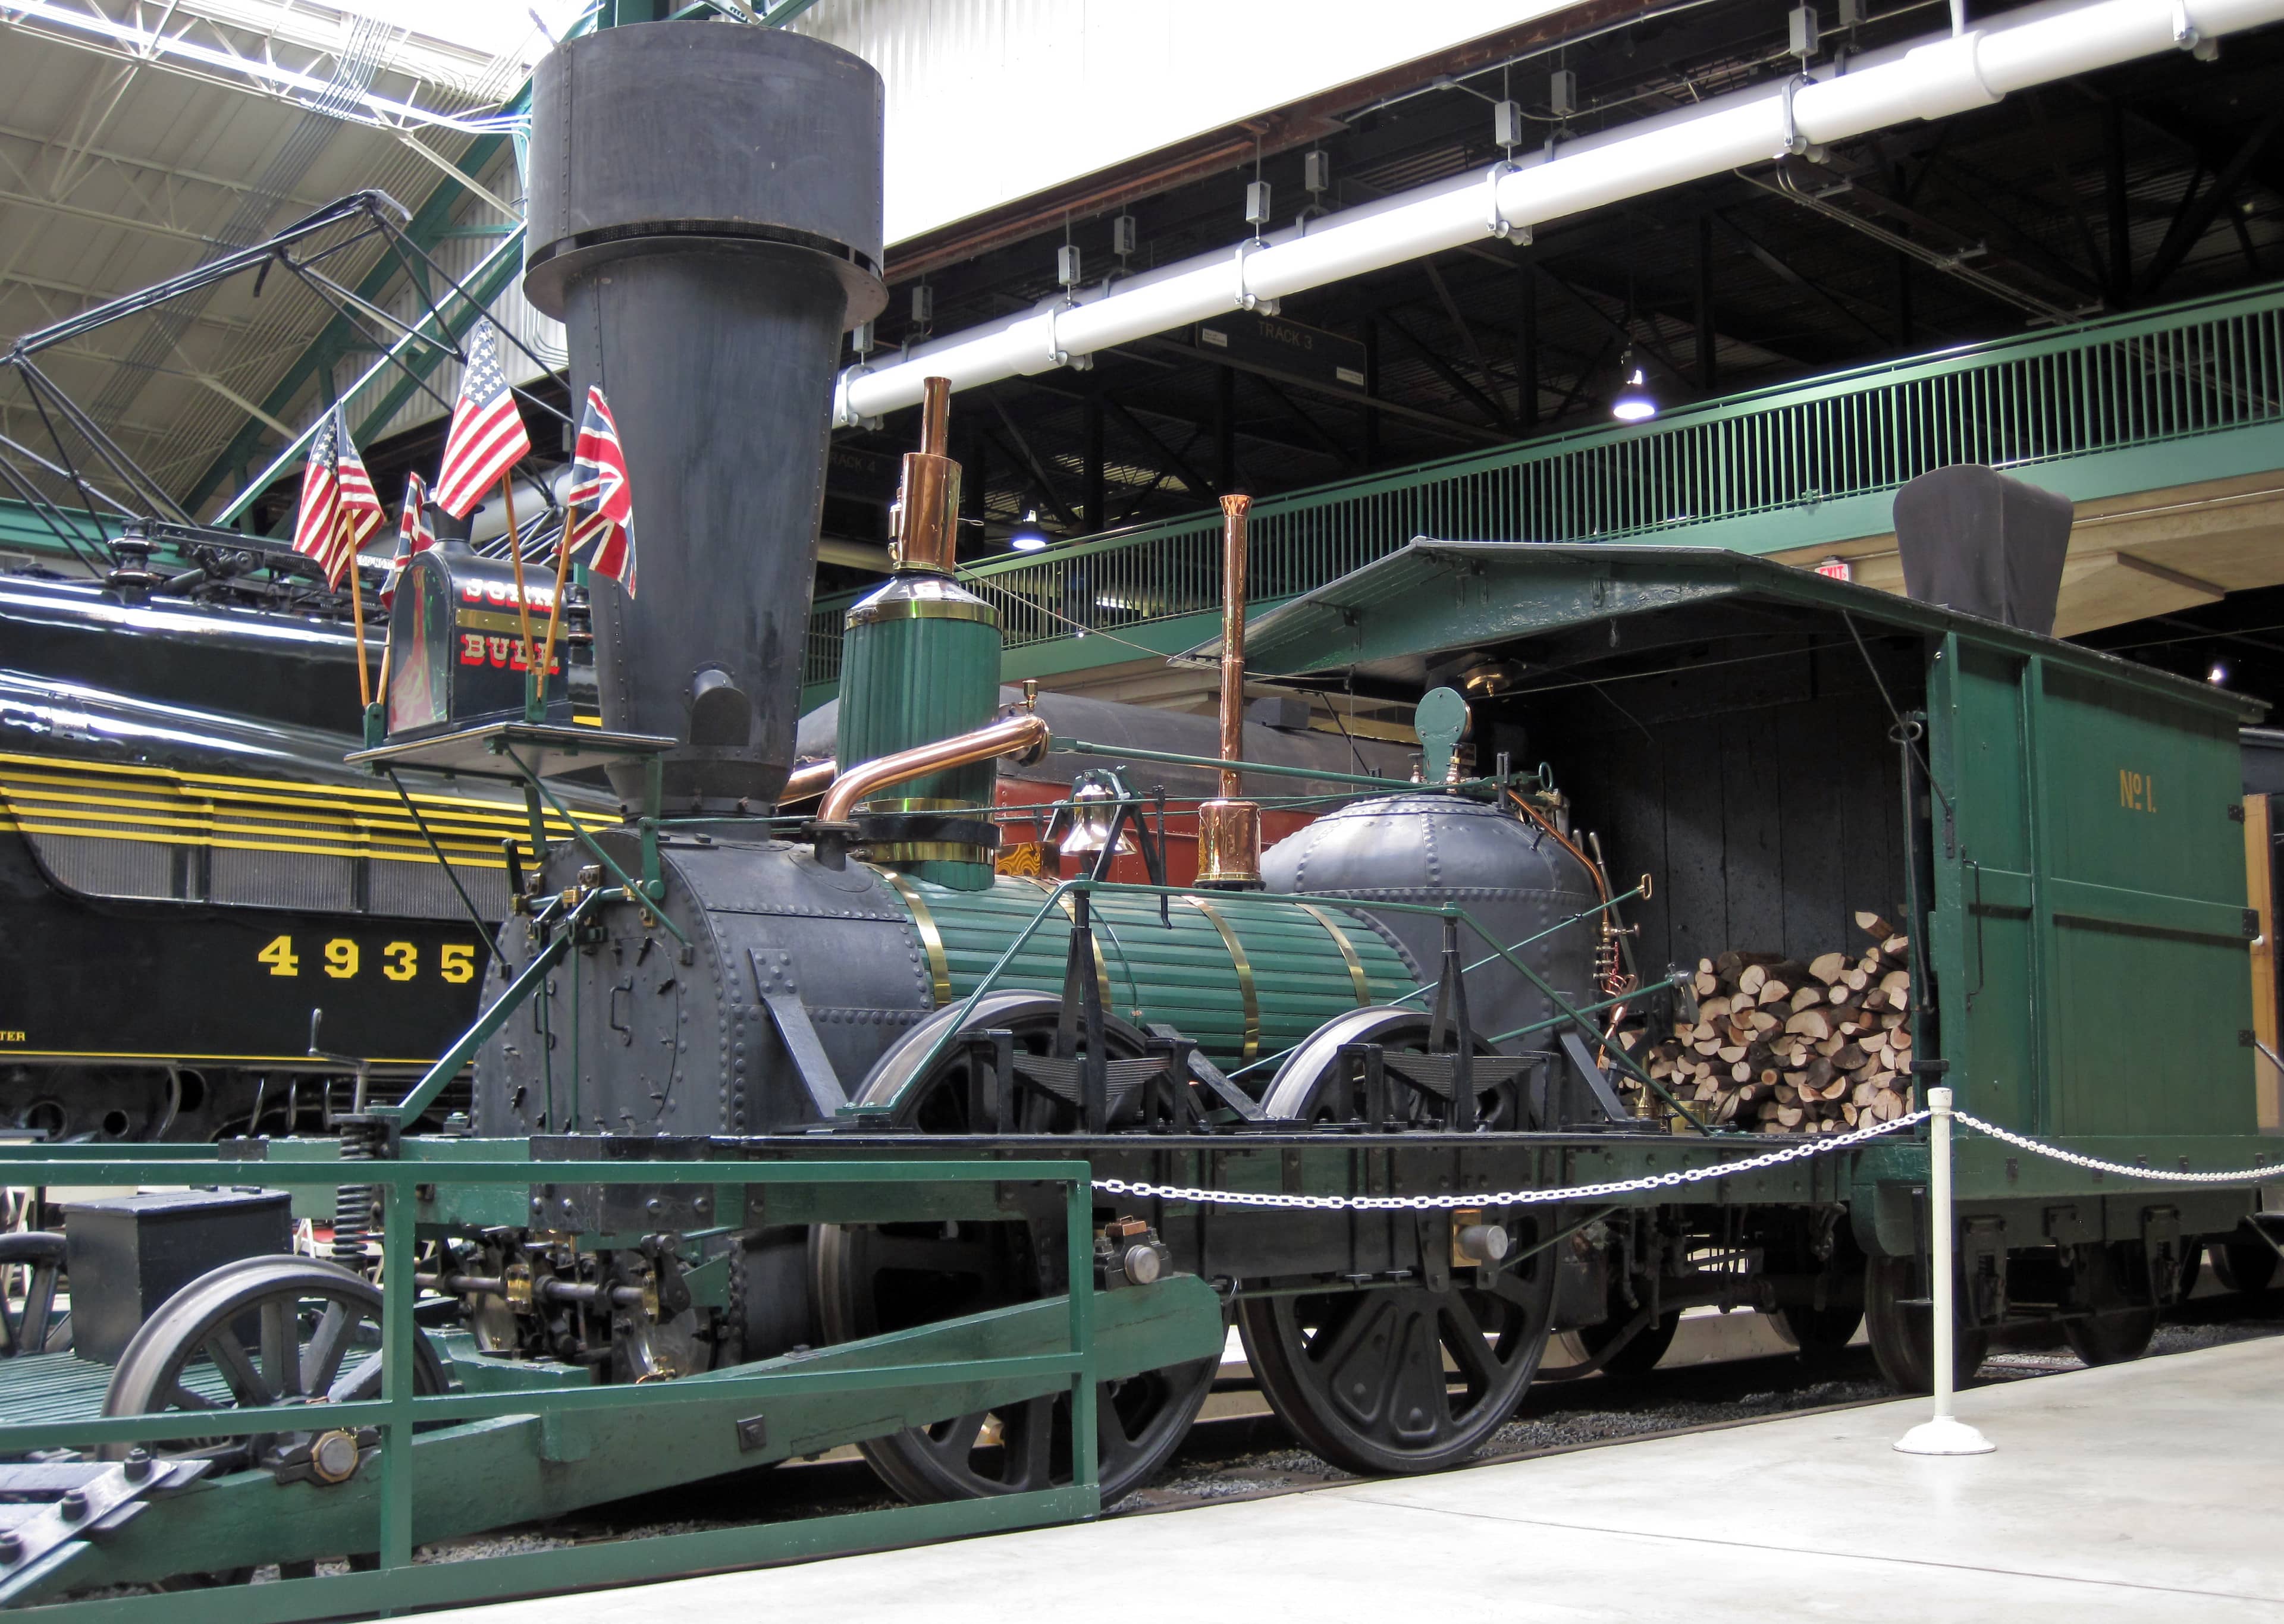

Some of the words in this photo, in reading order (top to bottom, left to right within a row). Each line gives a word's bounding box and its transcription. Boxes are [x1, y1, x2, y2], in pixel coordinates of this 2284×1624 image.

[1257, 319, 1300, 347] TRACK
[1304, 334, 1313, 350] 3
[829, 451, 862, 470] RACK
[258, 935, 475, 984] 4935
